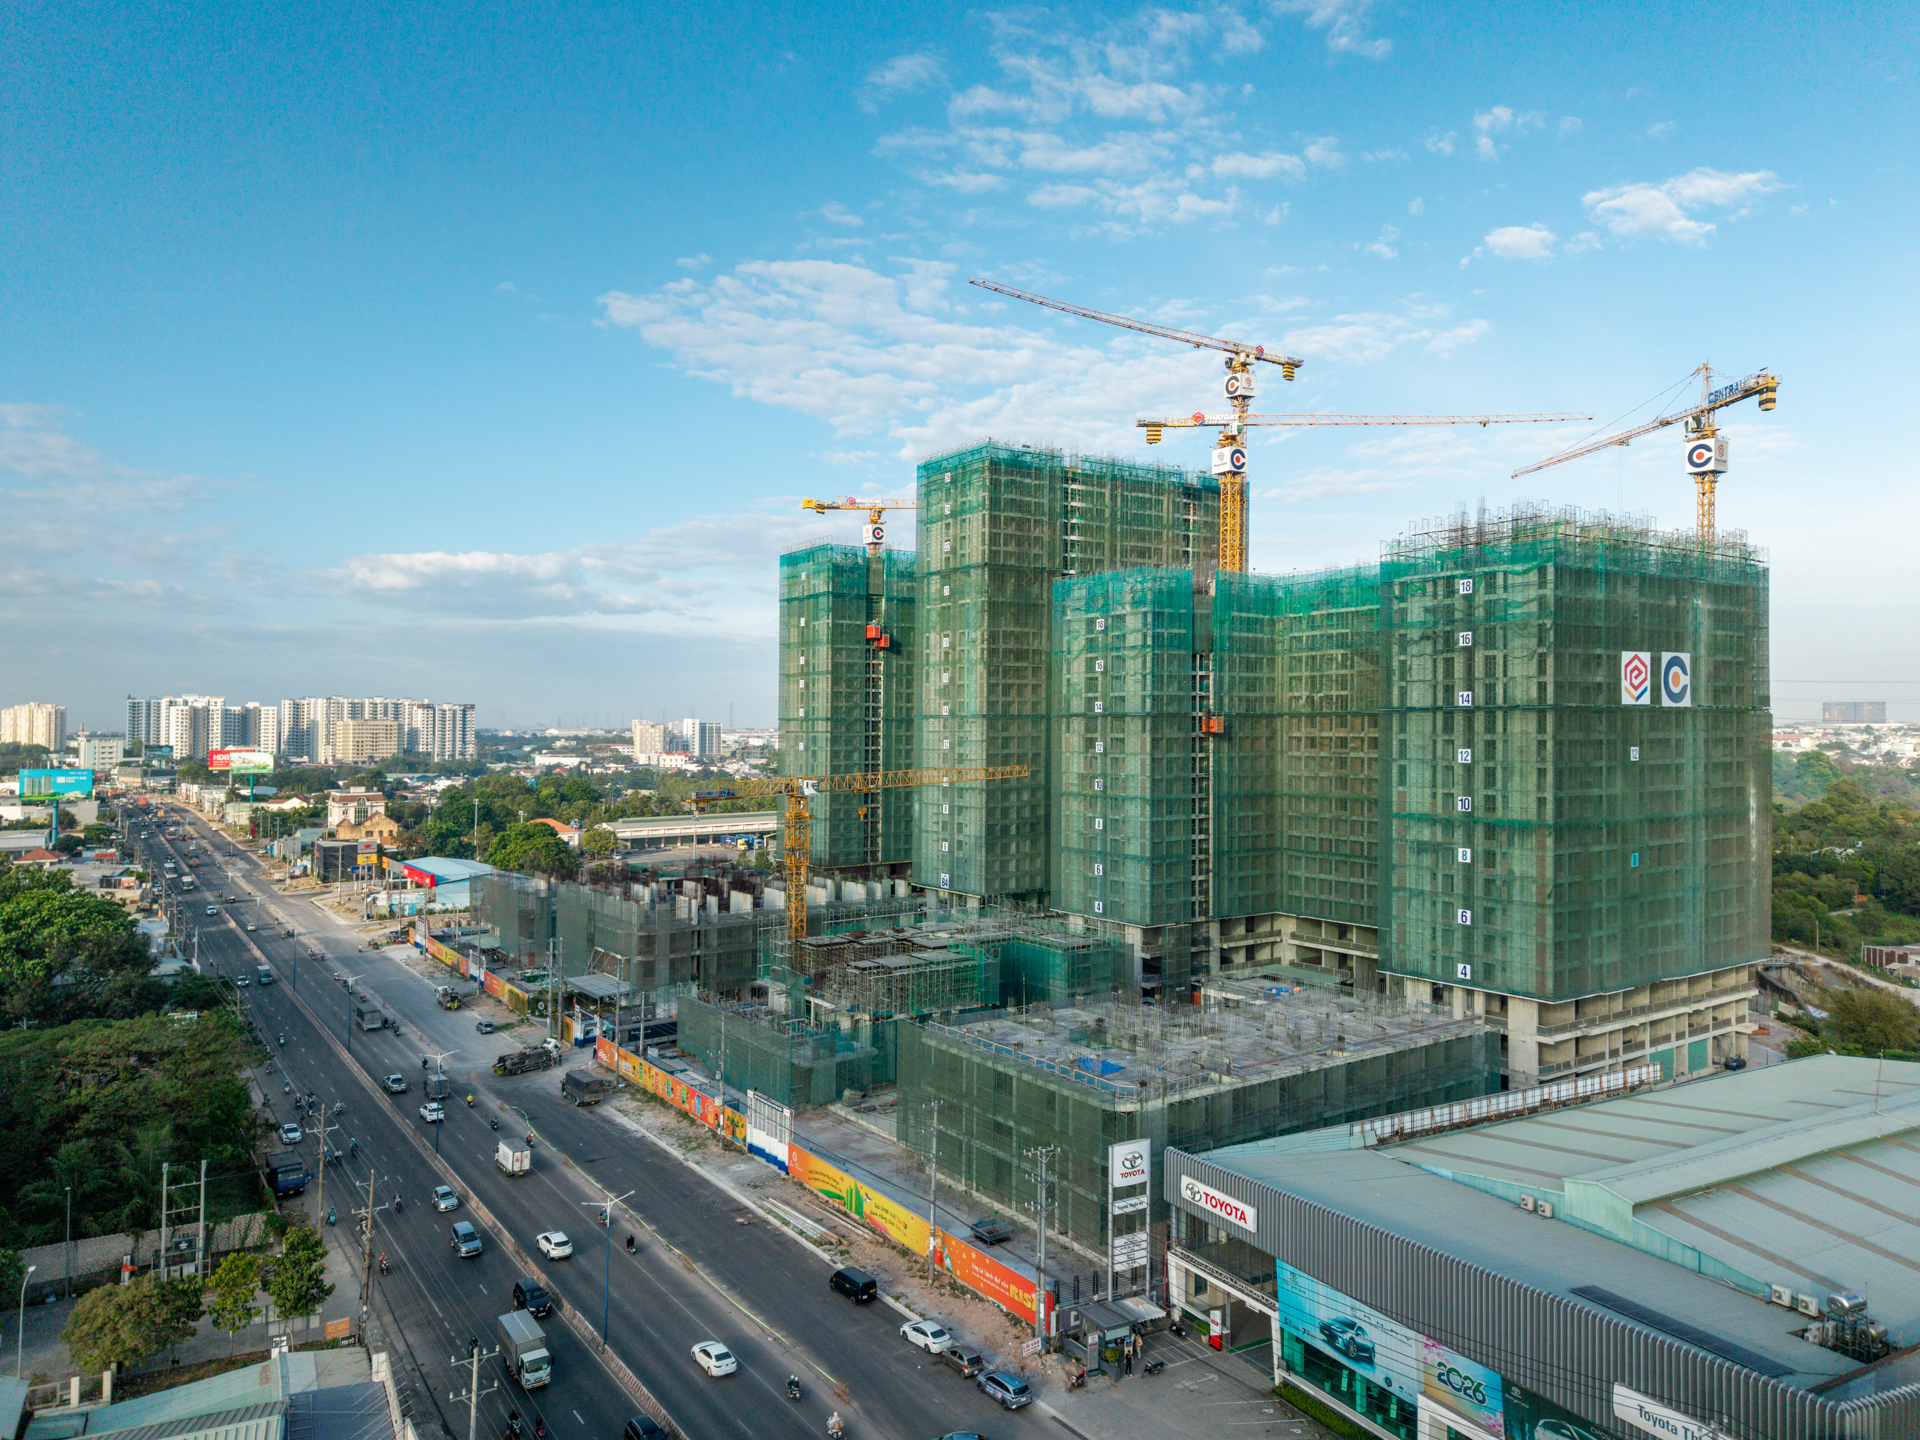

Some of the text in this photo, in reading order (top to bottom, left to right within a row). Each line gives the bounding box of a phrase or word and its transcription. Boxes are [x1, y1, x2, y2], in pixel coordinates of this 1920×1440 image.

[1708, 380, 1744, 404] CENTRAL
[1461, 581, 1471, 592] 18
[1098, 620, 1103, 628] 18
[1461, 633, 1470, 645] 16
[1460, 693, 1470, 704] 14
[1459, 750, 1469, 761] 12
[1631, 748, 1638, 760] 12
[1096, 780, 1102, 789] 10
[944, 805, 947, 814] 8
[1458, 798, 1470, 810] 10
[1097, 820, 1101, 828] 8
[1462, 850, 1467, 861] 8
[1632, 854, 1637, 866] 8
[1097, 865, 1100, 874] 6
[942, 877, 948, 887] B4
[1097, 902, 1101, 912] 4
[1461, 910, 1468, 923] 6
[1460, 965, 1467, 978] 4
[1120, 1169, 1145, 1178] TOYOTA
[1203, 1192, 1247, 1224] TOYOTA
[1437, 1361, 1488, 1406] 2026
[1637, 1404, 1678, 1436] Toyota
